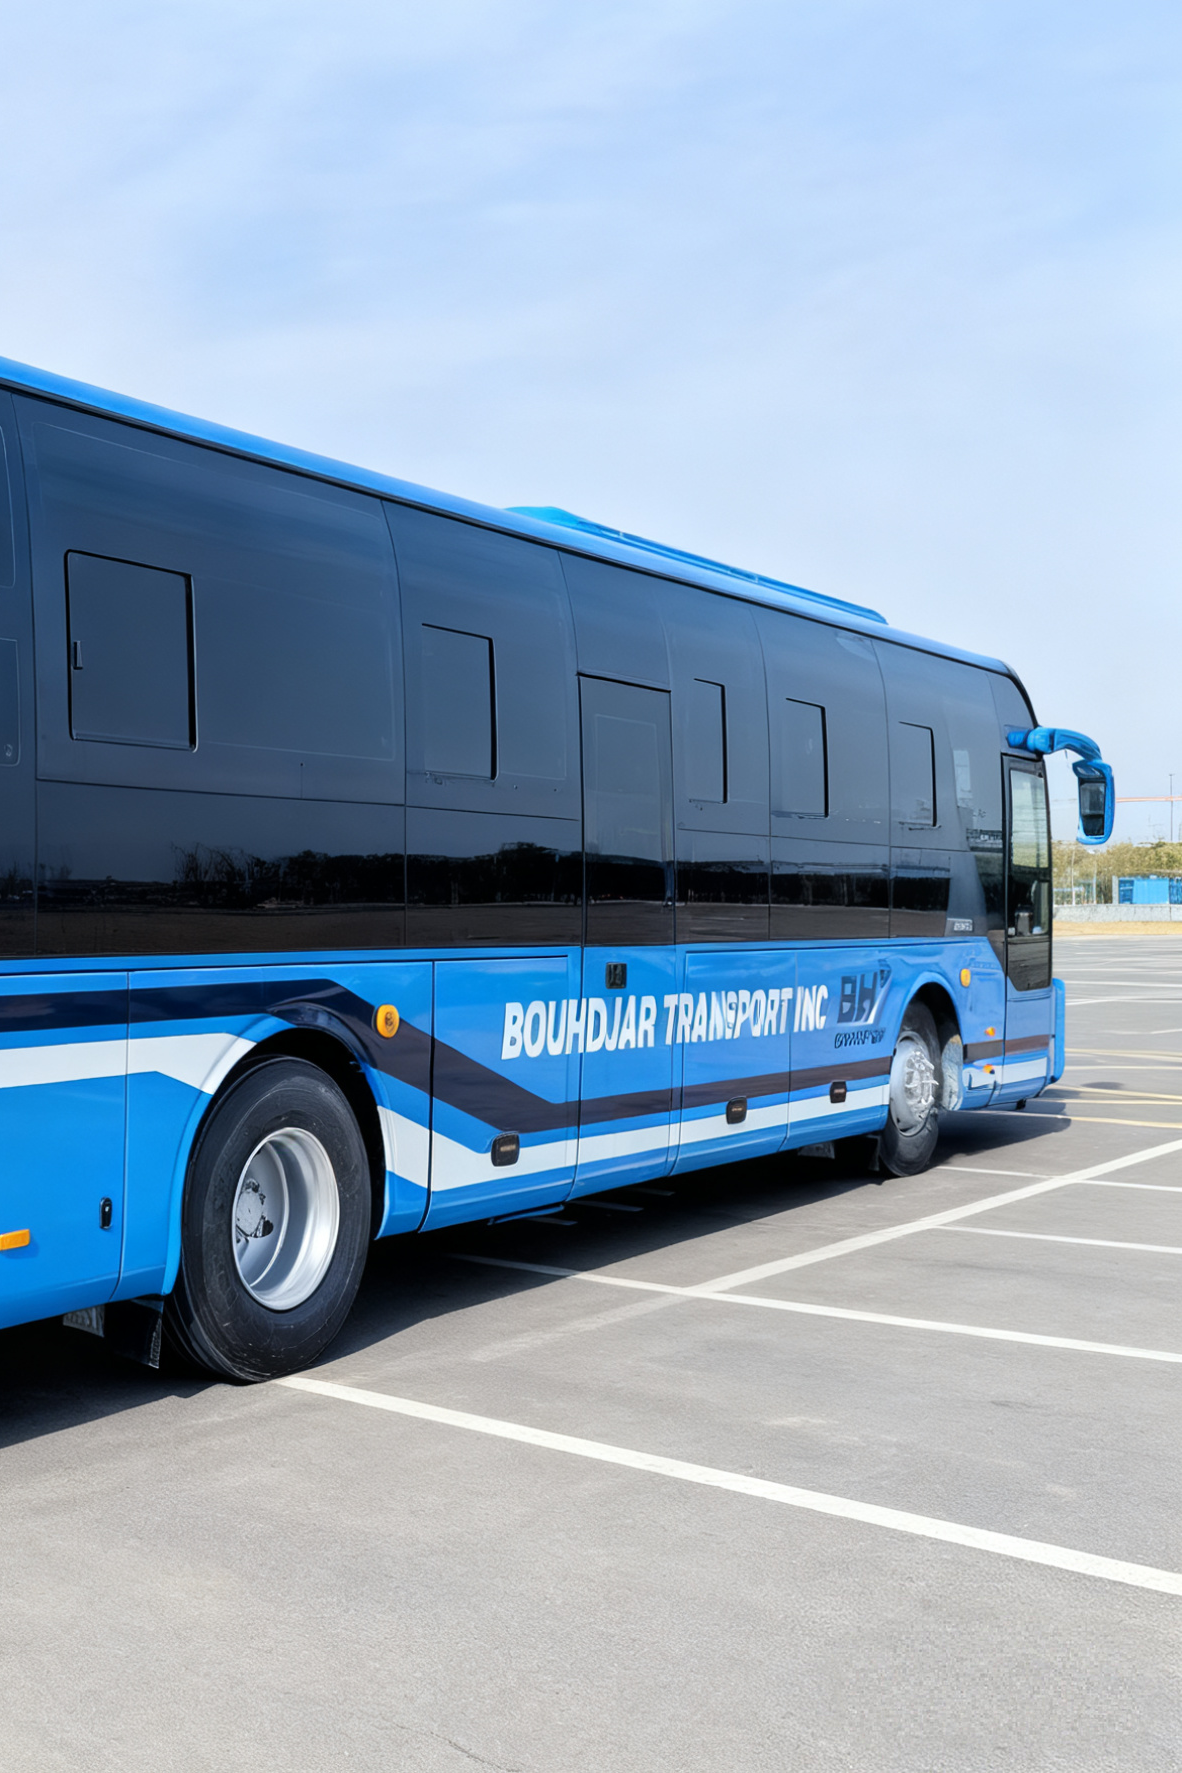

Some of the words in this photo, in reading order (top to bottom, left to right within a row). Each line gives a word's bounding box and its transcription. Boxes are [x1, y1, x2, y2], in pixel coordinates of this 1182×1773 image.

[501, 994, 657, 1061] BOUHDJAR
[663, 987, 794, 1046] TRANSPORT
[793, 984, 829, 1033] INC
